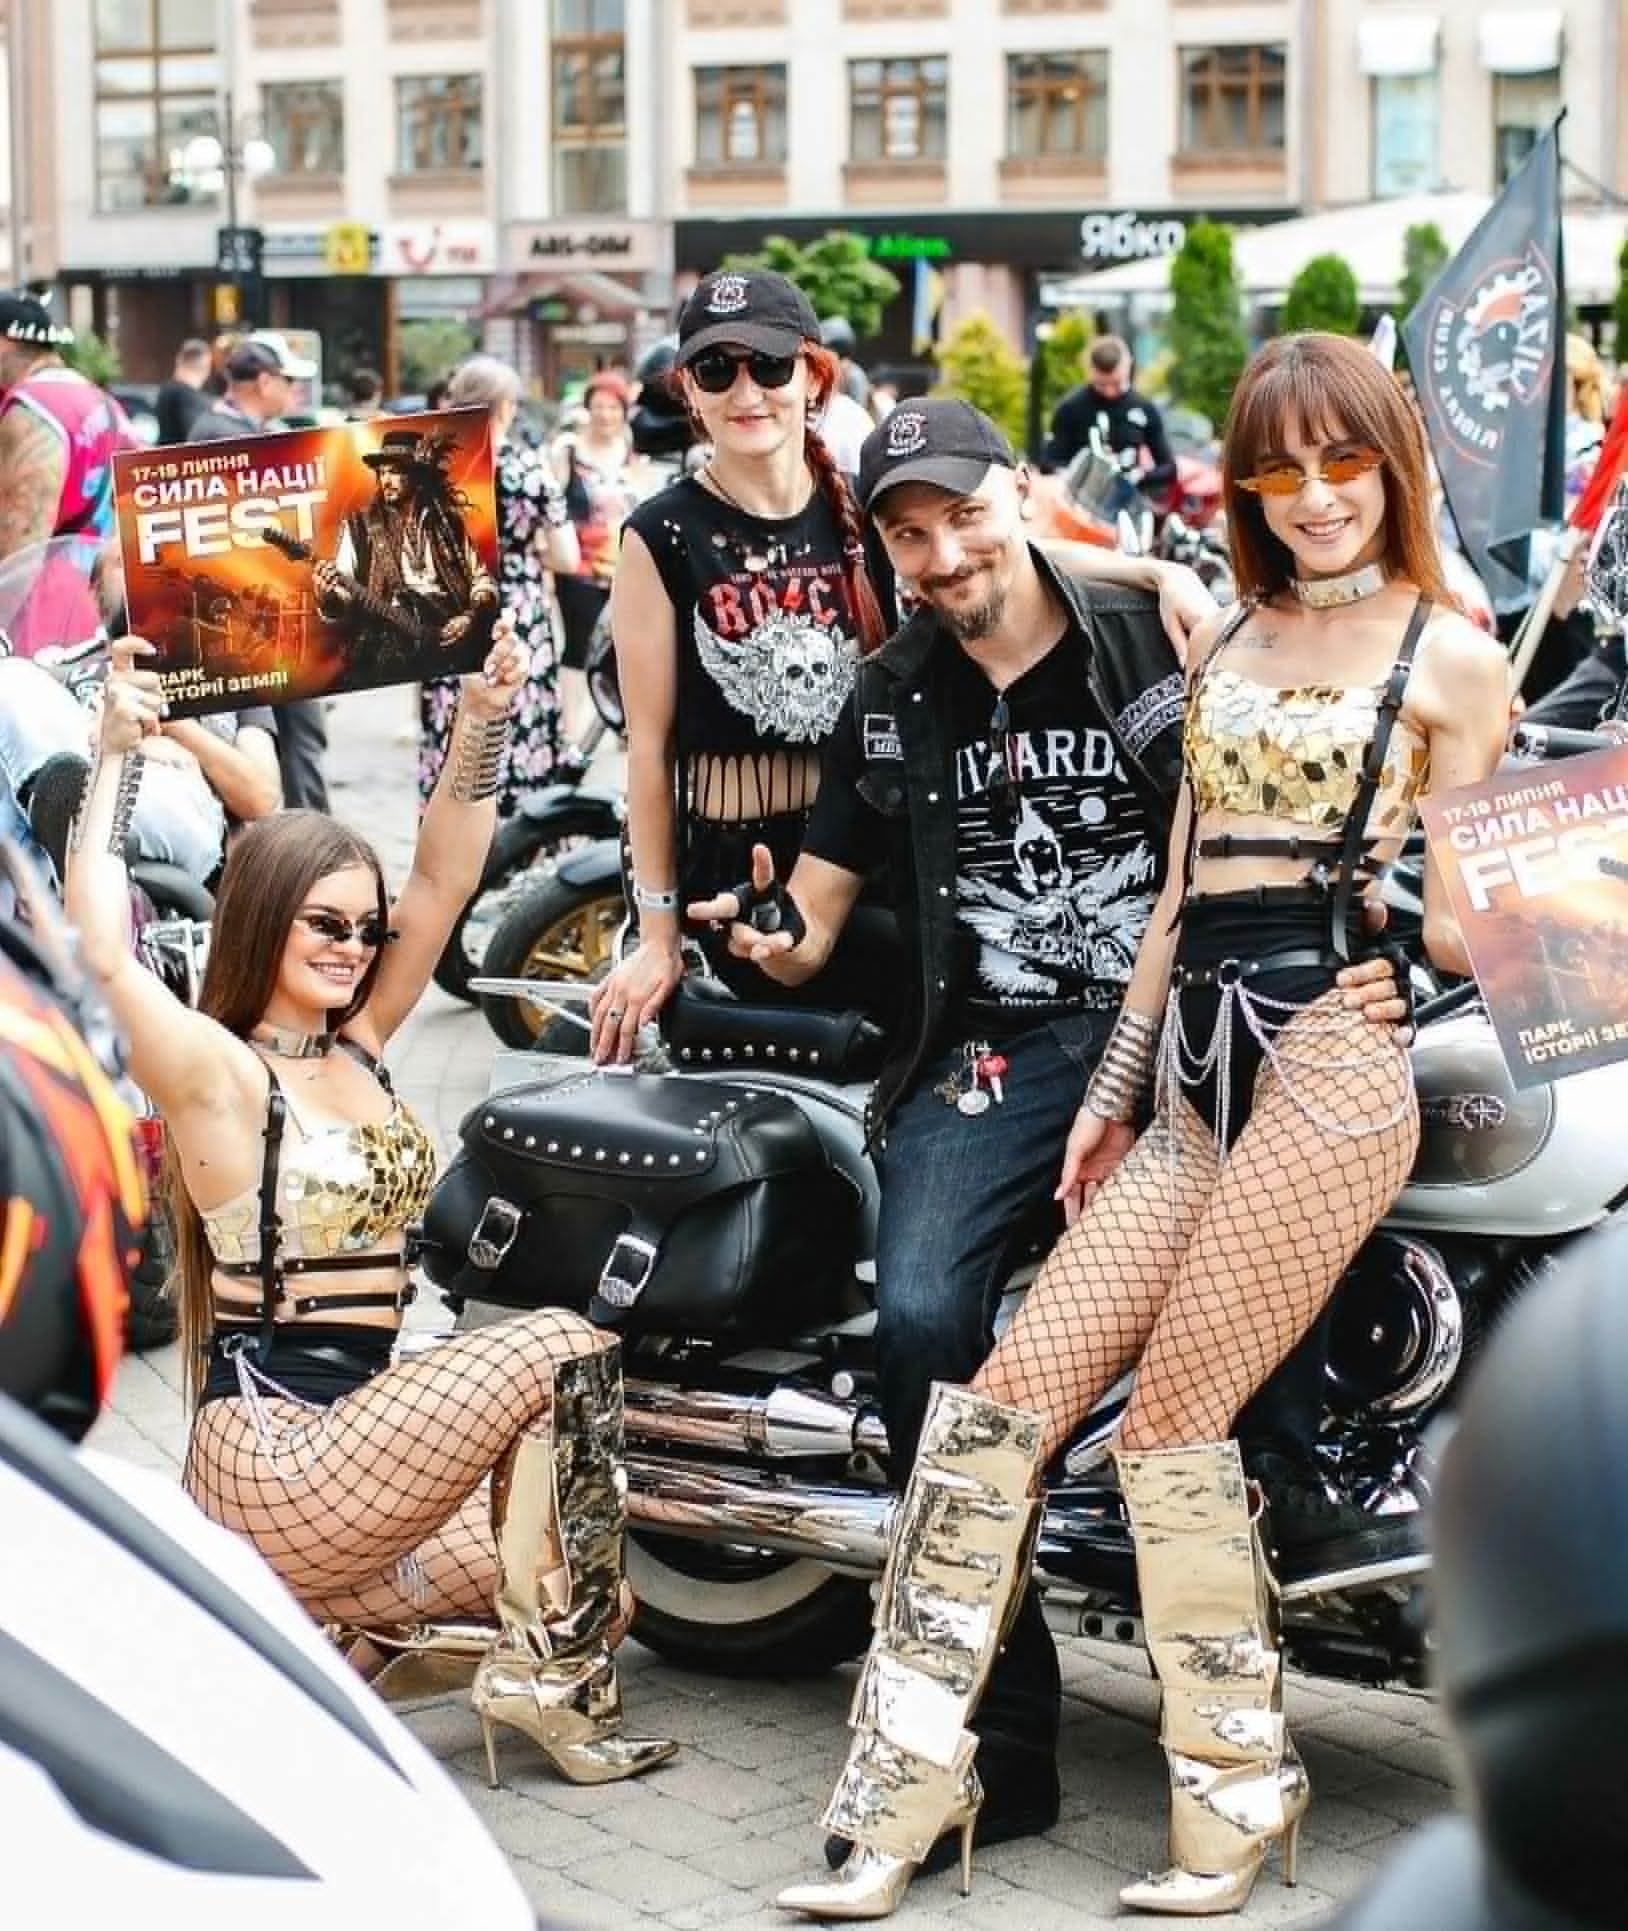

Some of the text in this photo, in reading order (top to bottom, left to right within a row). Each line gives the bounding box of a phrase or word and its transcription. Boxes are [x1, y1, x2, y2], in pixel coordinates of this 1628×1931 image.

[1081, 211, 1186, 258] Ябко
[133, 455, 327, 508] СИЛА НАЦІЇ
[181, 453, 250, 477] ЛИПНЯ
[135, 488, 329, 565] FEST
[1494, 779, 1566, 812] ЛИПНЯ
[1450, 808, 1552, 850] СИЛА
[1517, 1018, 1575, 1047] ПАРК
